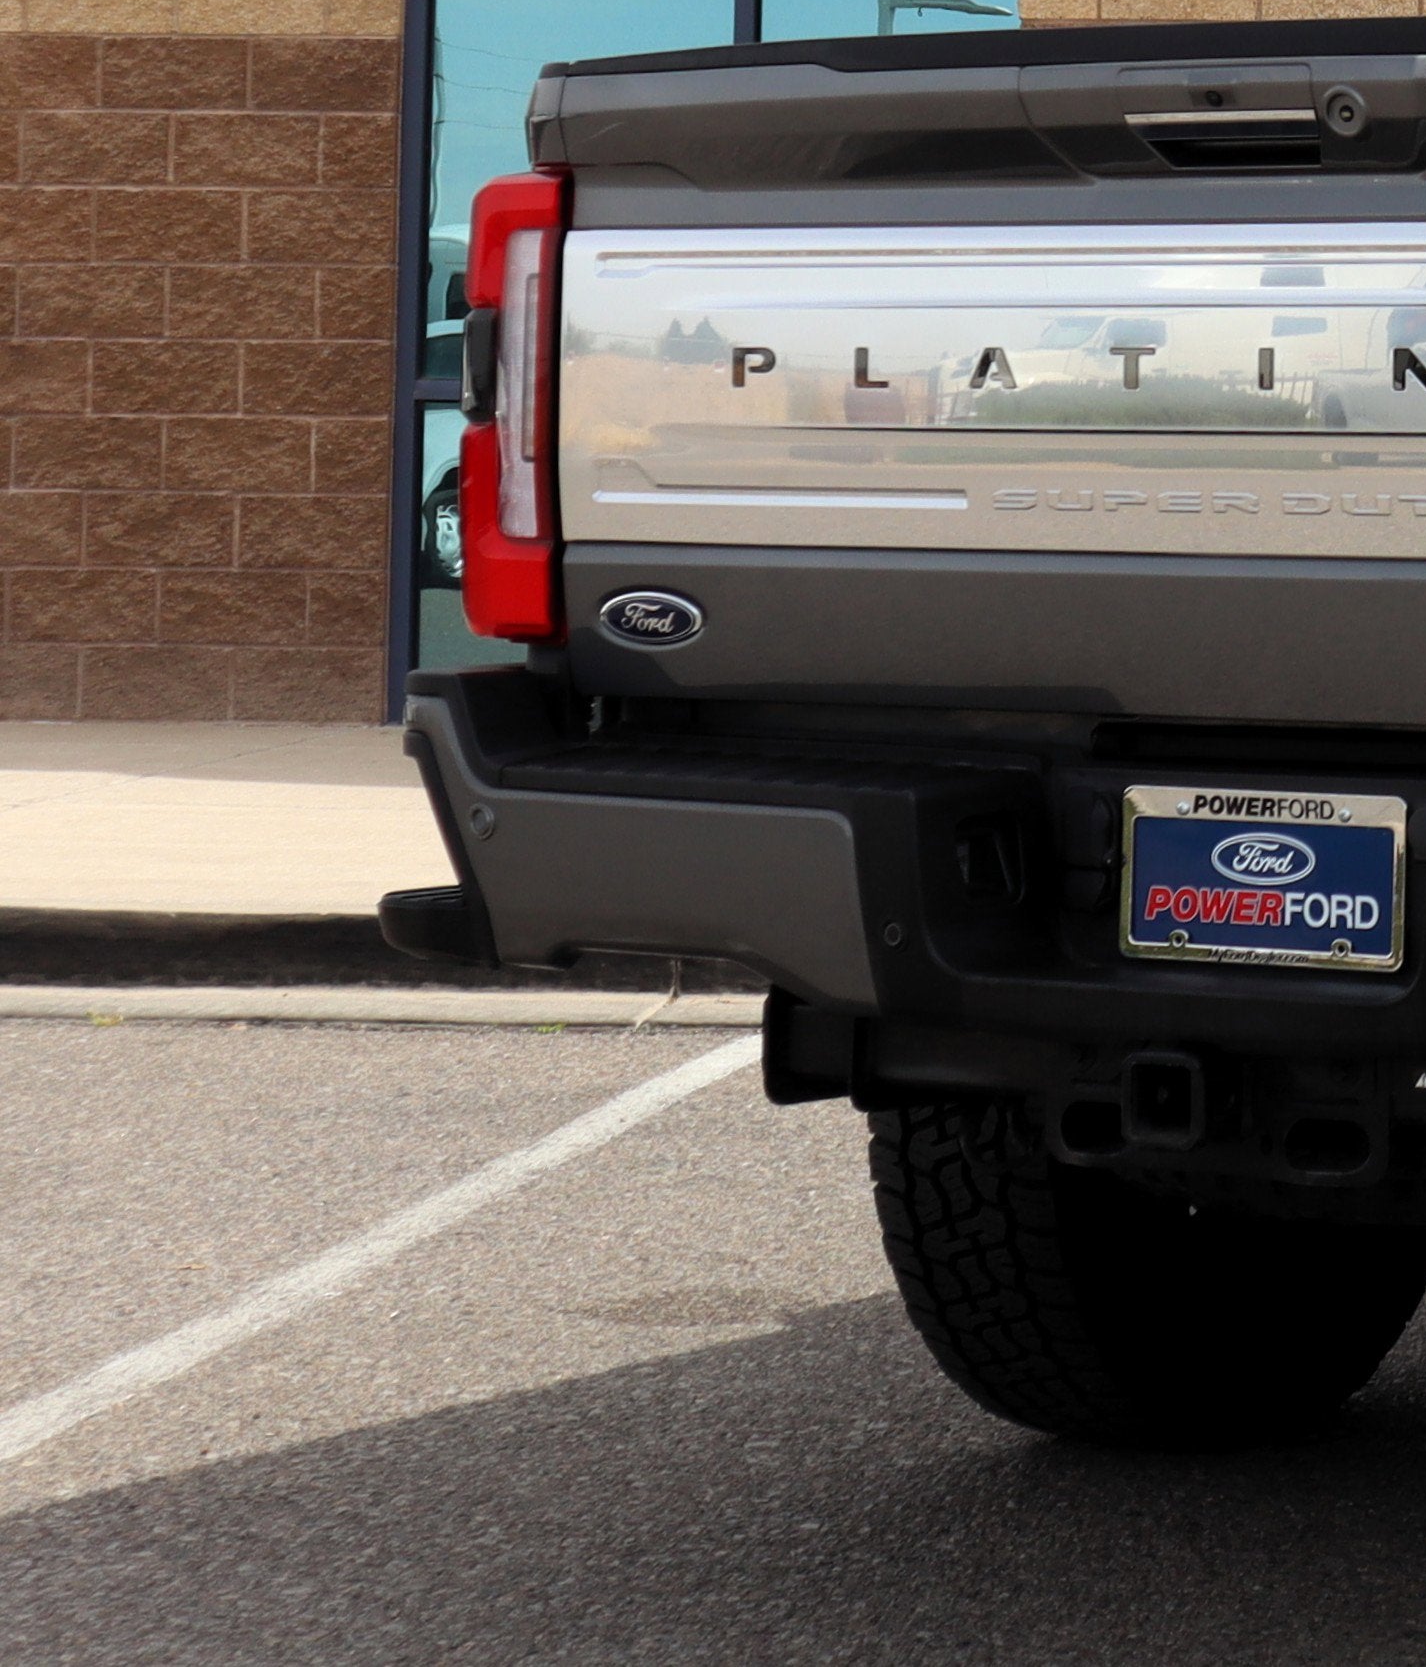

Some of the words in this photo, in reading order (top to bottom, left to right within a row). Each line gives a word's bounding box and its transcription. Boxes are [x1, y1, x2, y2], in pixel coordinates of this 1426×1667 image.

[991, 488, 1261, 516] SUPER
[621, 603, 676, 635] Ford
[1192, 794, 1335, 821] POWERFORD
[1231, 839, 1294, 875] Ford
[1144, 885, 1380, 931] POWERFORD
